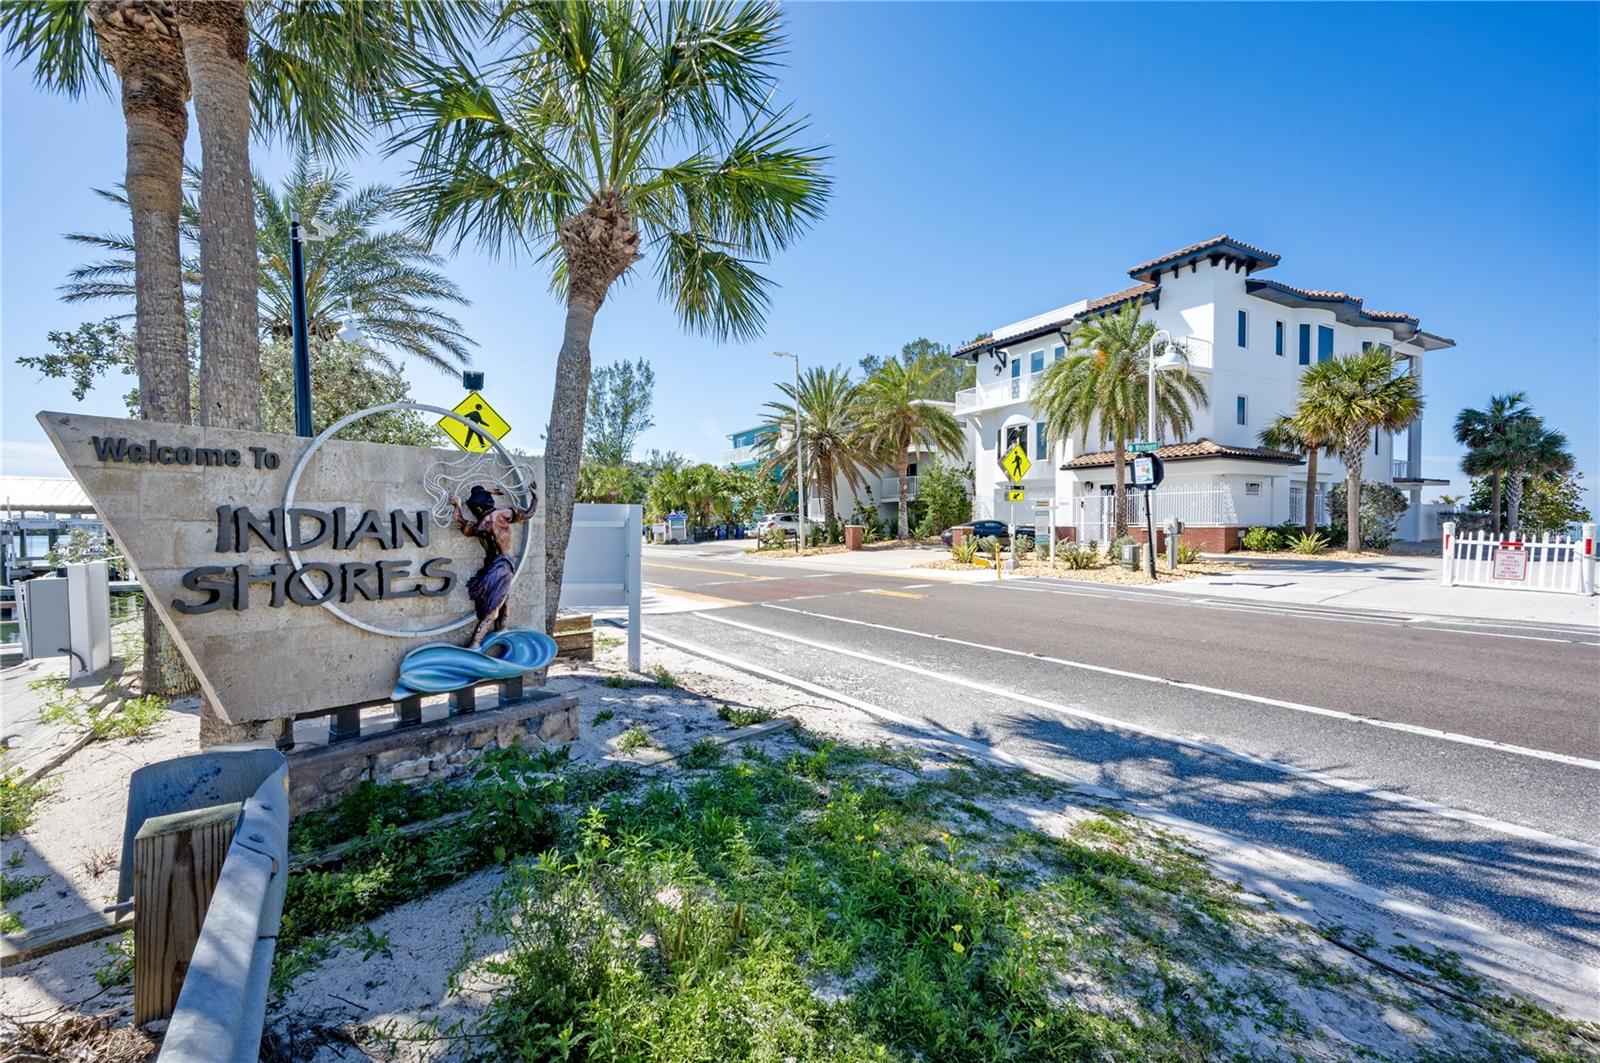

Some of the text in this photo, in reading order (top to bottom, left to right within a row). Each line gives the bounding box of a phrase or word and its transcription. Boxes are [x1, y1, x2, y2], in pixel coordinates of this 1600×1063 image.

[92, 436, 281, 470] Welcome To
[215, 504, 429, 553] INDIAN
[172, 557, 458, 614] SHORES
